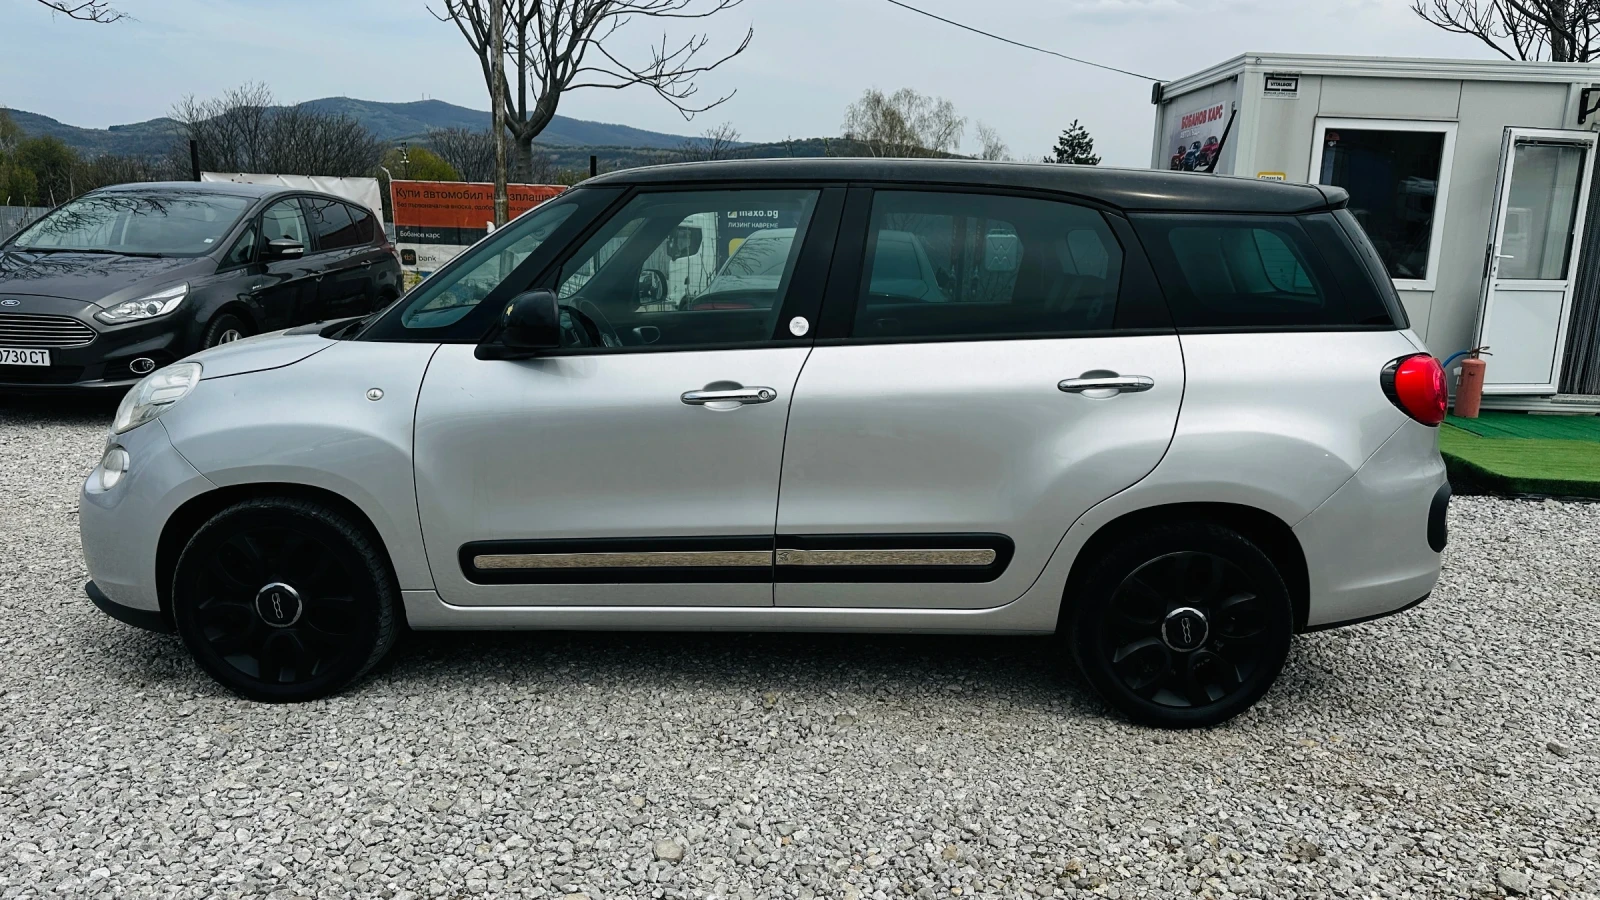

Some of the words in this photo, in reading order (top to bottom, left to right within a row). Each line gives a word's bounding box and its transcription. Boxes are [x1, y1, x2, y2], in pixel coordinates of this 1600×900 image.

[1181, 109, 1207, 130] БОБАНОВ
[1207, 104, 1224, 122] КАРС
[396, 188, 420, 199] Купи
[423, 189, 483, 200] автомобил
[418, 254, 437, 262] bank
[30, 350, 46, 364] CT
